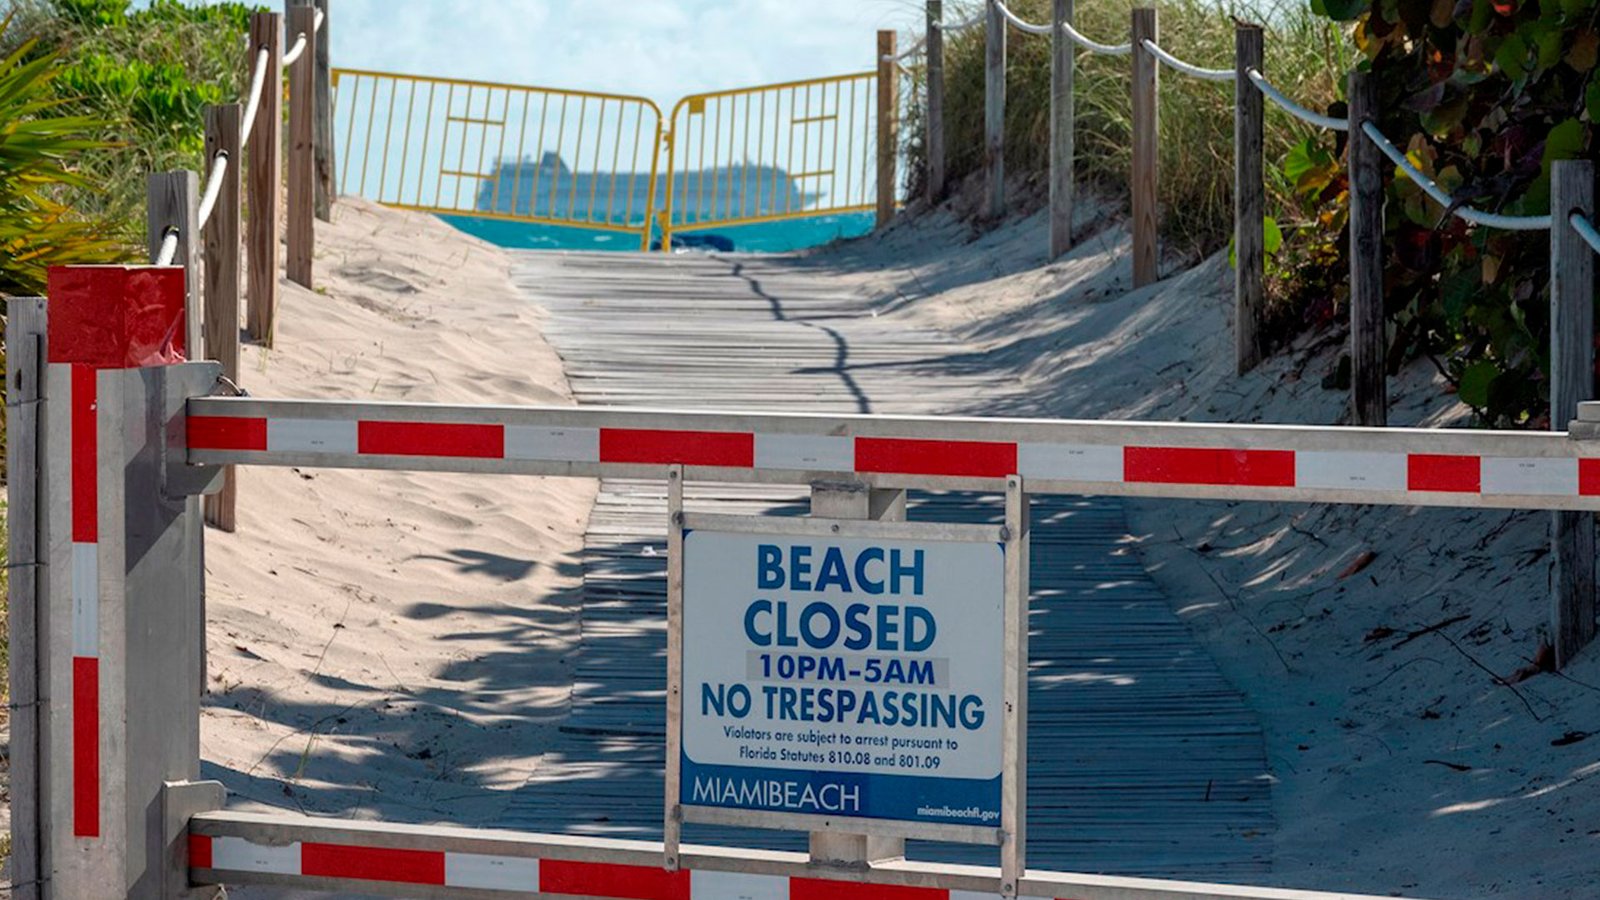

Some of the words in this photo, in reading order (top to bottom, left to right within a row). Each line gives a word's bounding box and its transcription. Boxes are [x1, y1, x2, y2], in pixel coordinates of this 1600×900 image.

[758, 544, 924, 595] BEACH
[744, 600, 937, 651] CLOSED
[760, 654, 935, 685] 10PM-5AM
[701, 683, 751, 718] NO
[763, 686, 984, 730] TRESPASSING
[723, 726, 772, 741] Violators
[775, 732, 793, 742] are
[797, 731, 837, 746] subject
[839, 734, 852, 744] to
[855, 735, 888, 746] arrest
[892, 737, 942, 750] pursuant
[946, 739, 958, 750] to
[740, 746, 776, 760] Florida
[781, 748, 825, 763] Statutes
[829, 751, 871, 765] 810.08
[875, 754, 895, 766] and
[899, 755, 940, 768] 801.09
[693, 777, 859, 811] MIAMIBEACH
[917, 807, 999, 821] miamibeachfl.gov
